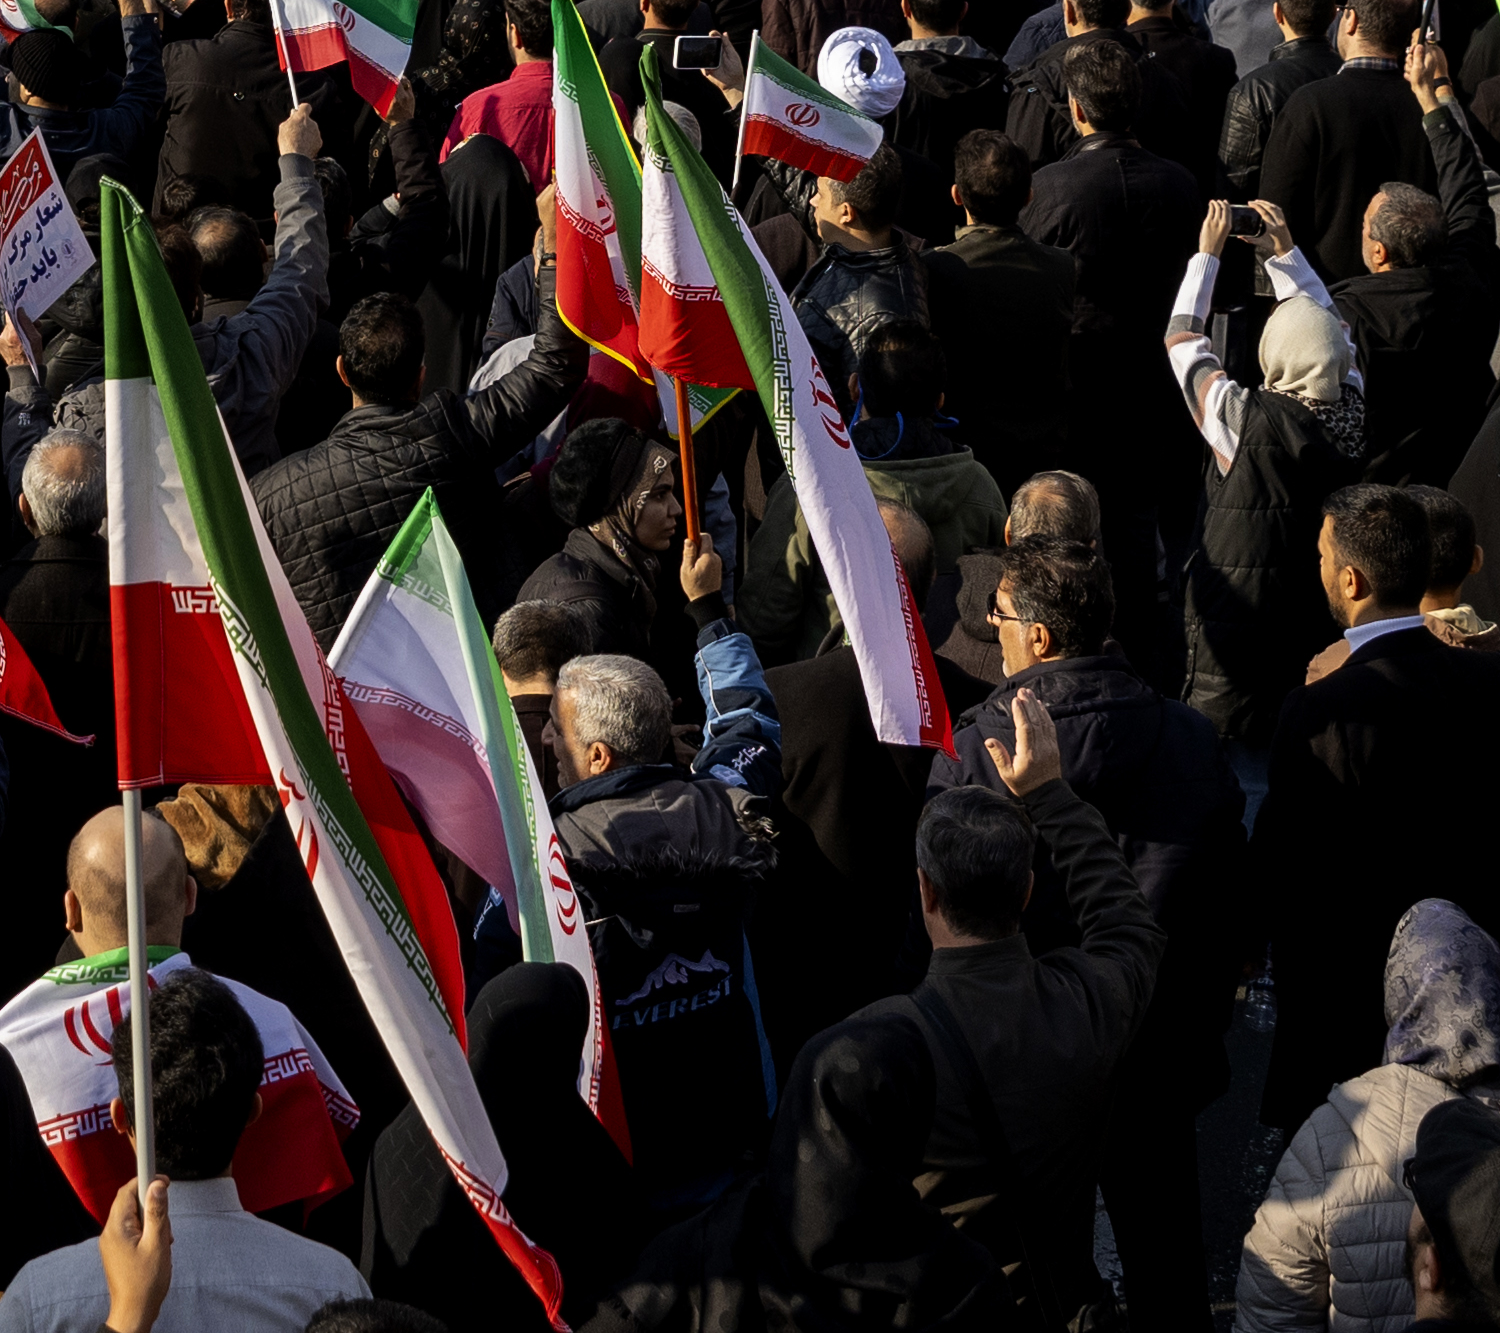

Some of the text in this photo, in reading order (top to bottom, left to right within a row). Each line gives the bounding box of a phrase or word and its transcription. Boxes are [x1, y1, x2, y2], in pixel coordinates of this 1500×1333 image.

[7, 191, 64, 265] شعار مرگ
[30, 245, 61, 284] باید
[612, 973, 733, 1031] EVEREST
